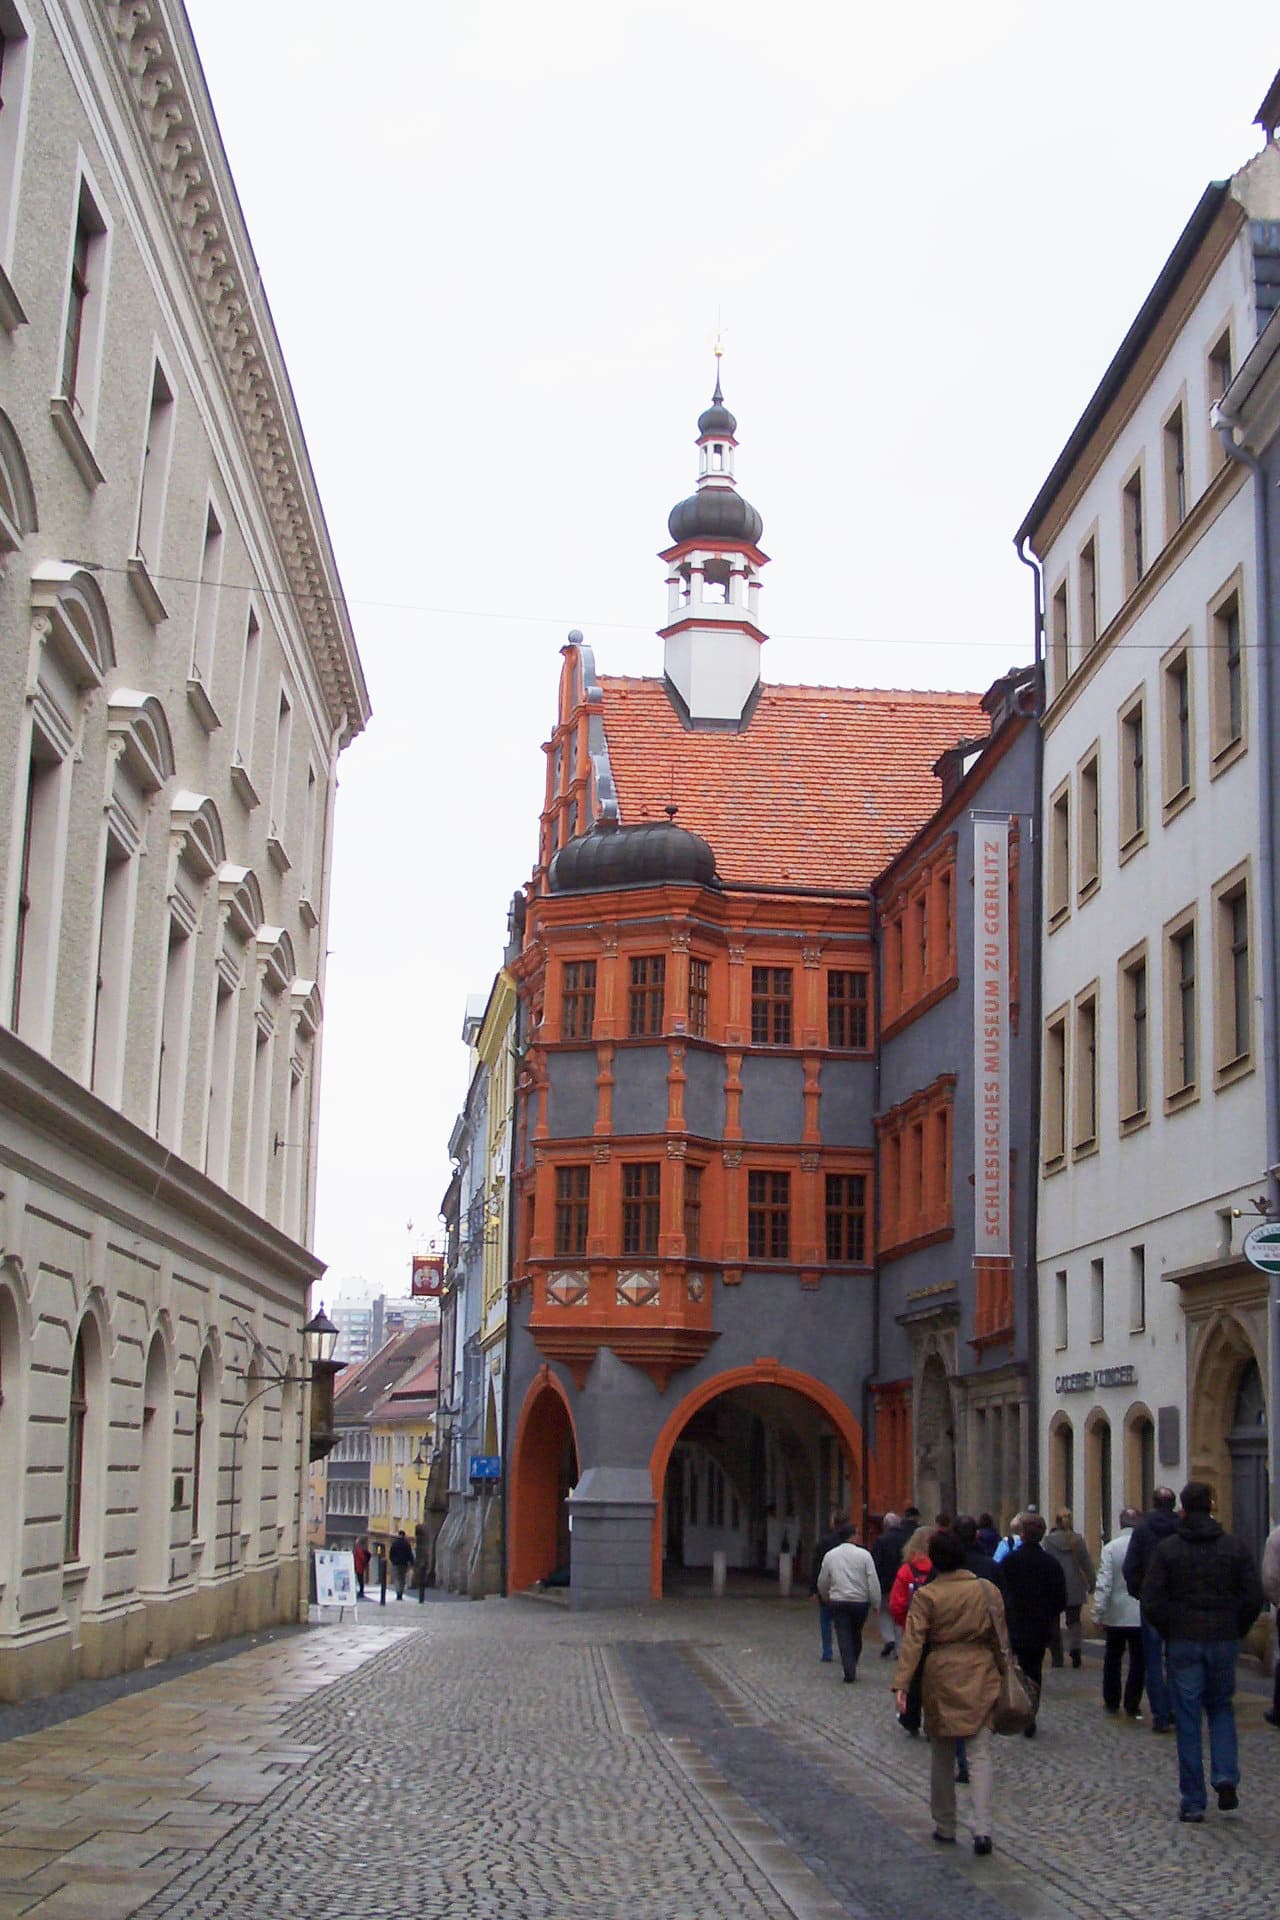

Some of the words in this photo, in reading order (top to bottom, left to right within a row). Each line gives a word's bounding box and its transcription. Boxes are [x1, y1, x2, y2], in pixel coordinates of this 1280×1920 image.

[984, 943, 1001, 972] ZU
[984, 980, 1001, 1074] MUSEUM
[984, 1080, 1001, 1236] SCHLESISCHES
